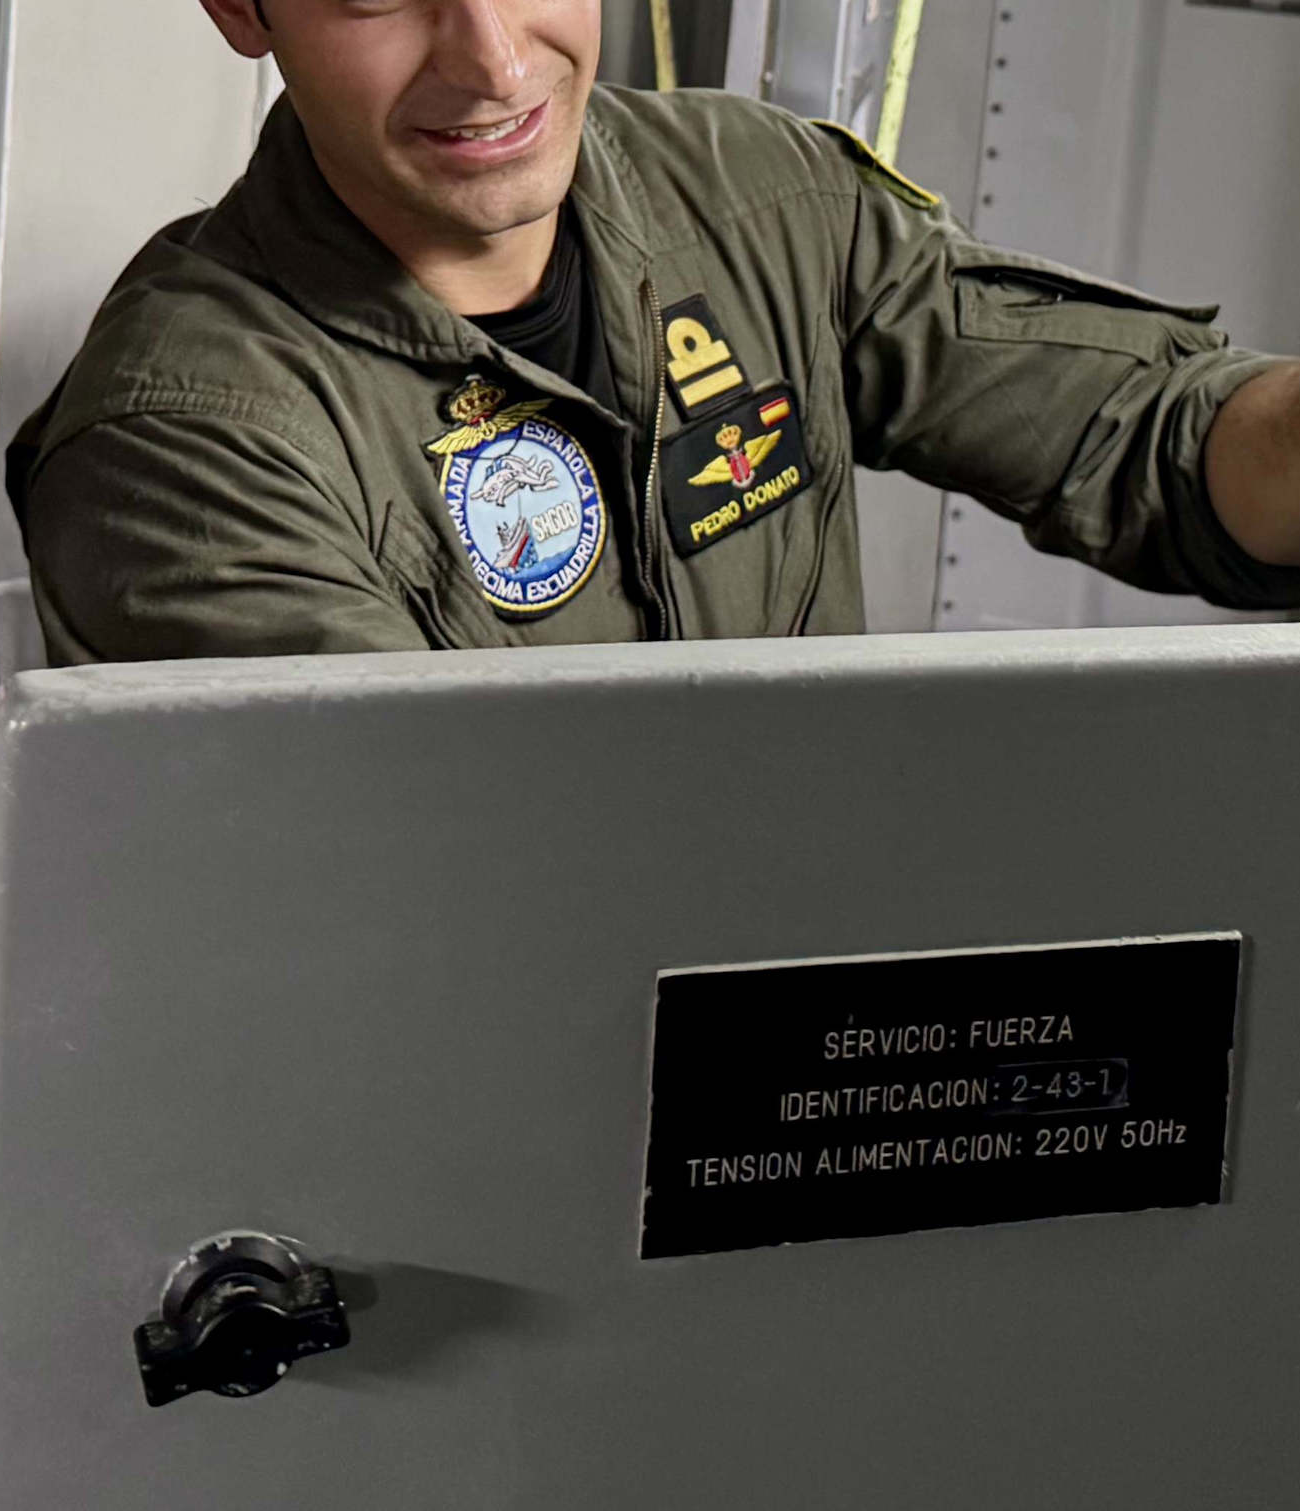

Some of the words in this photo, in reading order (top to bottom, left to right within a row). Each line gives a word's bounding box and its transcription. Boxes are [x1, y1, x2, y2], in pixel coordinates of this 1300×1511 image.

[690, 500, 741, 543] PEDRO
[743, 465, 801, 512] DONATO
[526, 504, 600, 602] ESCUADRILLA
[824, 1023, 957, 1060] SERVICIO:
[969, 1015, 1074, 1048] FUERZA
[780, 1078, 1000, 1121] IDENTIFICACION:
[1011, 1068, 1110, 1102] 2-43-1
[686, 1152, 802, 1187] TENSION
[815, 1132, 1022, 1176] ALIMENTACION:
[1035, 1124, 1108, 1156] 220V
[1121, 1119, 1187, 1148] 50Hz
